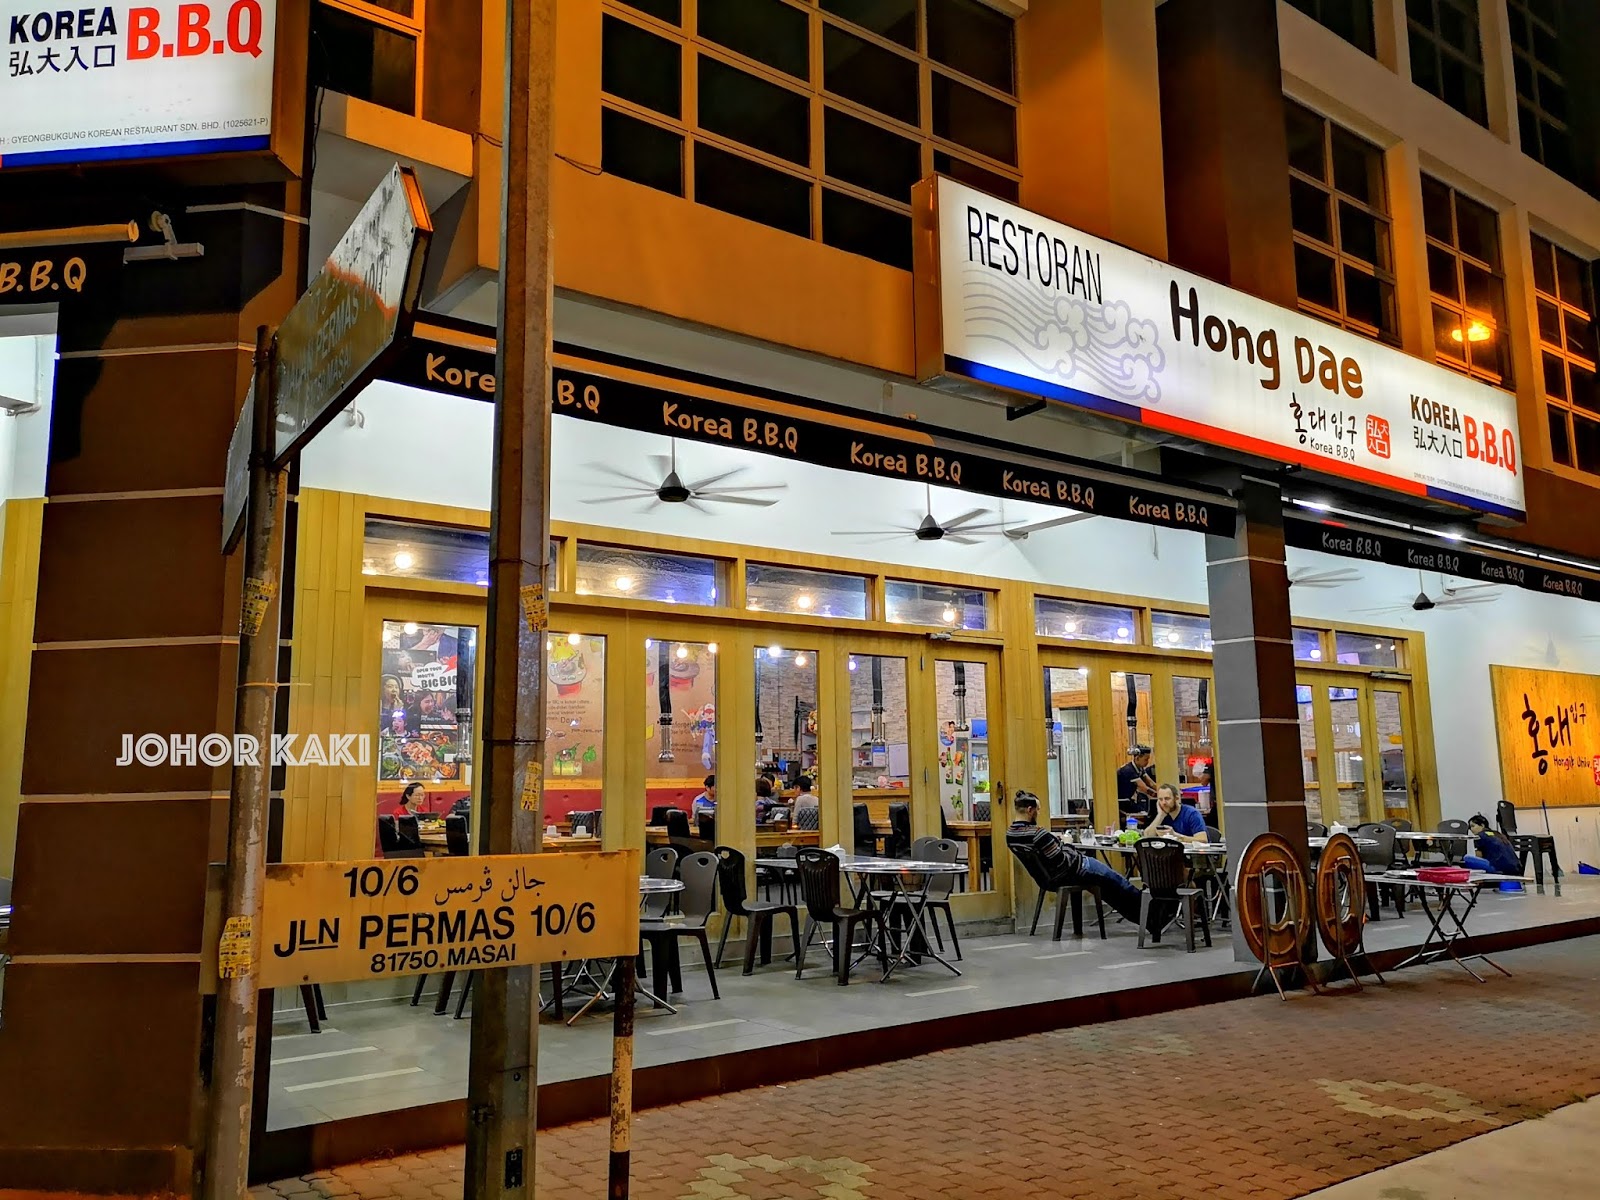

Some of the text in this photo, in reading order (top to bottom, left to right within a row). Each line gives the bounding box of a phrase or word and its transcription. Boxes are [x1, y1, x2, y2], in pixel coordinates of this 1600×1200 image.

[9, 7, 117, 44] KOREA
[126, 0, 263, 61] B.B.Q
[9, 45, 116, 77] 弘大入口
[11, 130, 86, 144] GYEONGBUKGUNG
[88, 128, 122, 138] KOREAN
[124, 124, 178, 136] RESTAURANT
[180, 122, 200, 131] SDN.
[201, 120, 220, 130] BHD.
[222, 117, 269, 129] (1025621-P)
[967, 205, 1102, 305] RESTORAN
[0, 257, 87, 293] B.B.Q
[1170, 279, 1364, 399] Hong Dae
[426, 352, 600, 414] Kore .B.Q
[662, 400, 798, 453] Korea B.B.Q
[1289, 392, 1357, 445] 홍대입구
[1410, 393, 1461, 434] KOREA
[1310, 437, 1356, 461] Korea B.B.Q
[1413, 425, 1463, 459] 弘大入口
[1463, 414, 1517, 477] B.B.Q
[850, 441, 962, 485] Korea B.B.Q
[1002, 469, 1095, 509] Korea B.B.Q
[1129, 495, 1209, 527] Korea B.B.Q
[1322, 532, 1382, 558] Korea B.B.Q
[1407, 549, 1460, 572] Korea B.B.Q
[1481, 561, 1525, 583] Korea B.B.Q
[1542, 575, 1583, 596] Korea B.B.Q
[344, 865, 419, 898] 10/6
[273, 902, 596, 957] JLN PERMAS 10/6
[370, 943, 516, 974] 81750 MASAI
